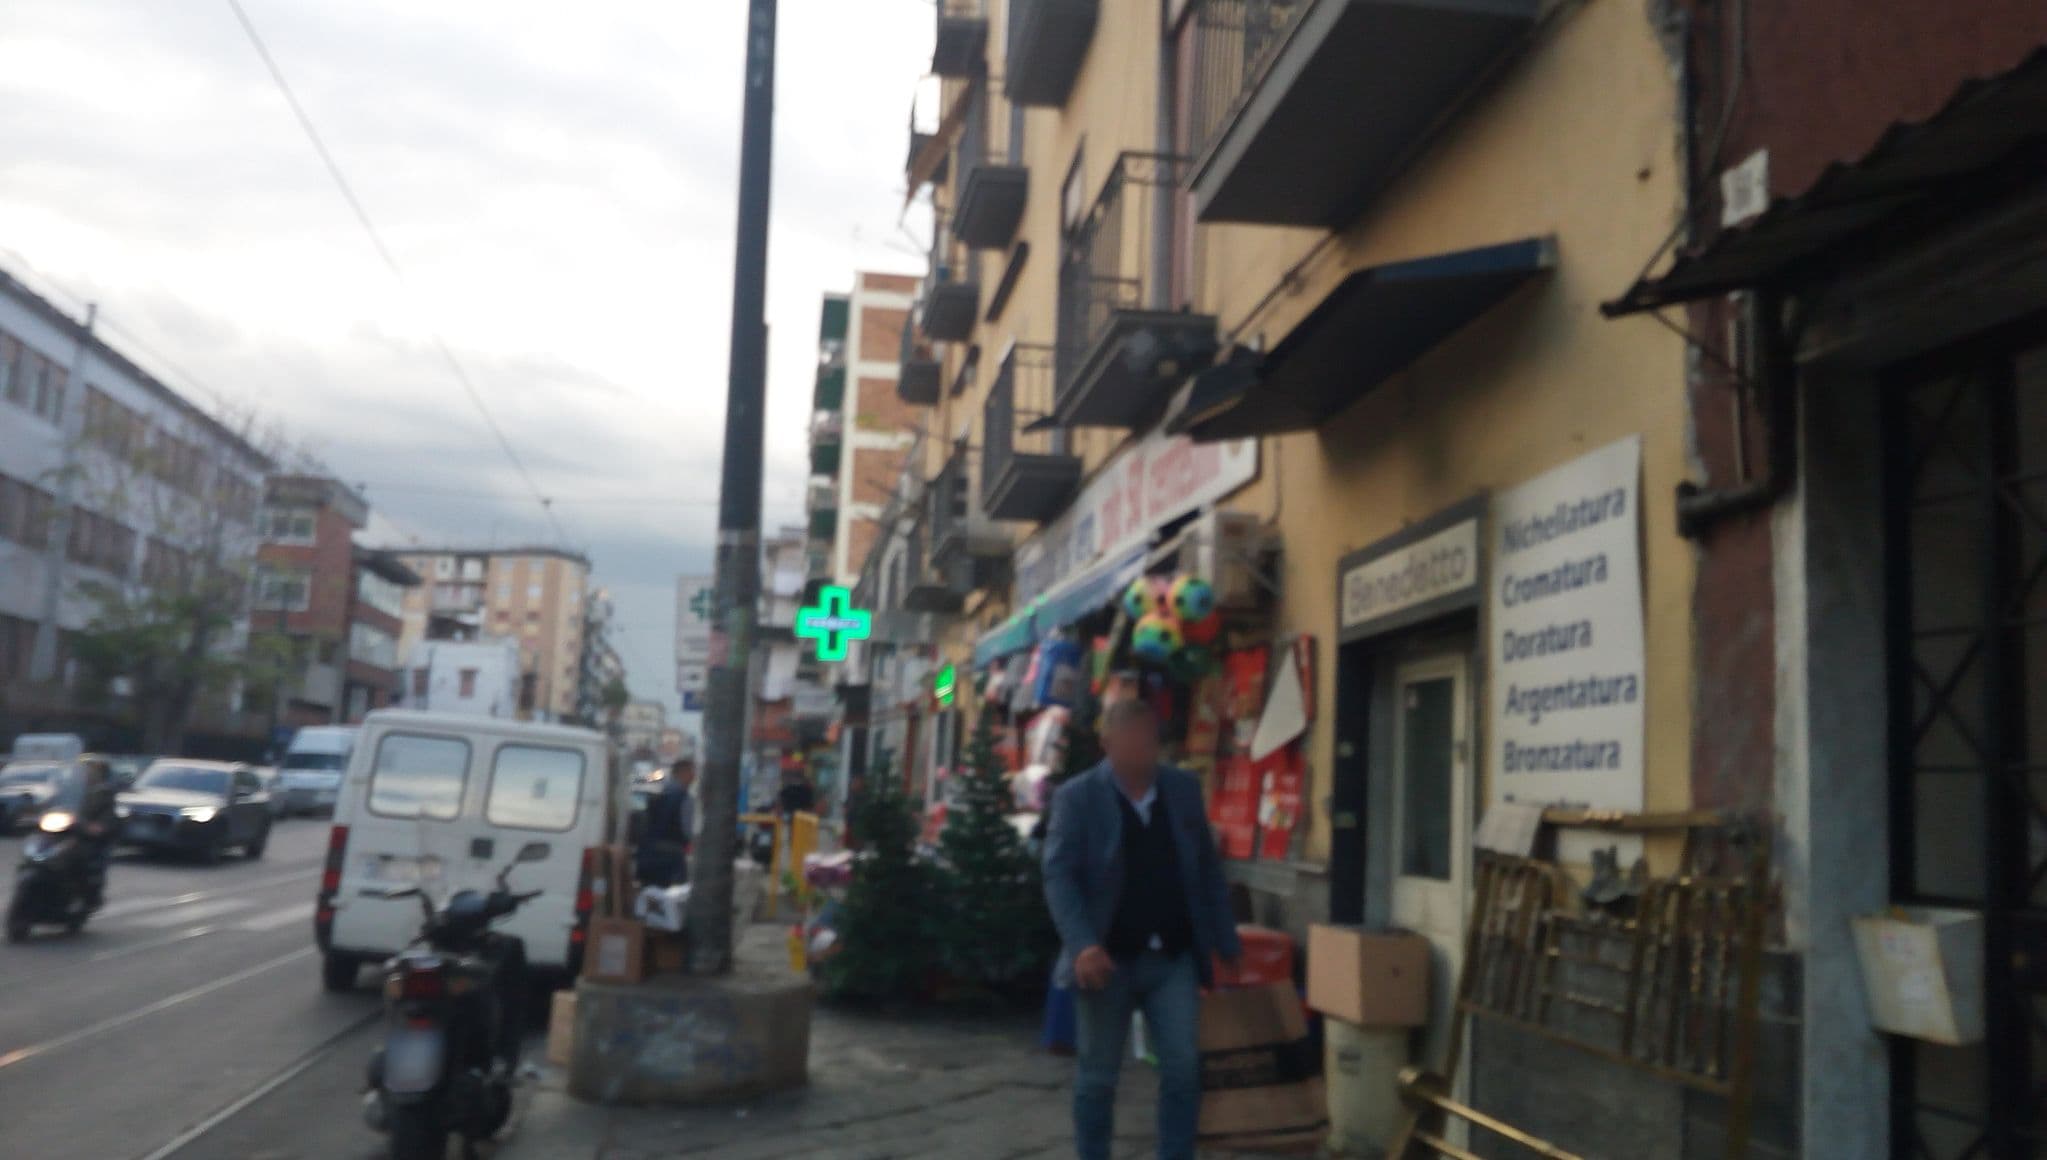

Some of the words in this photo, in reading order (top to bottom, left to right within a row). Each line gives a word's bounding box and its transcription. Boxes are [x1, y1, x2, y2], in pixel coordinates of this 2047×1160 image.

[1349, 545, 1467, 616] Benedetto
[1502, 553, 1608, 608] Cromatura
[1503, 618, 1592, 664] Doratura
[1505, 674, 1637, 725] Argentatura
[1504, 738, 1621, 773] Bronzatura
